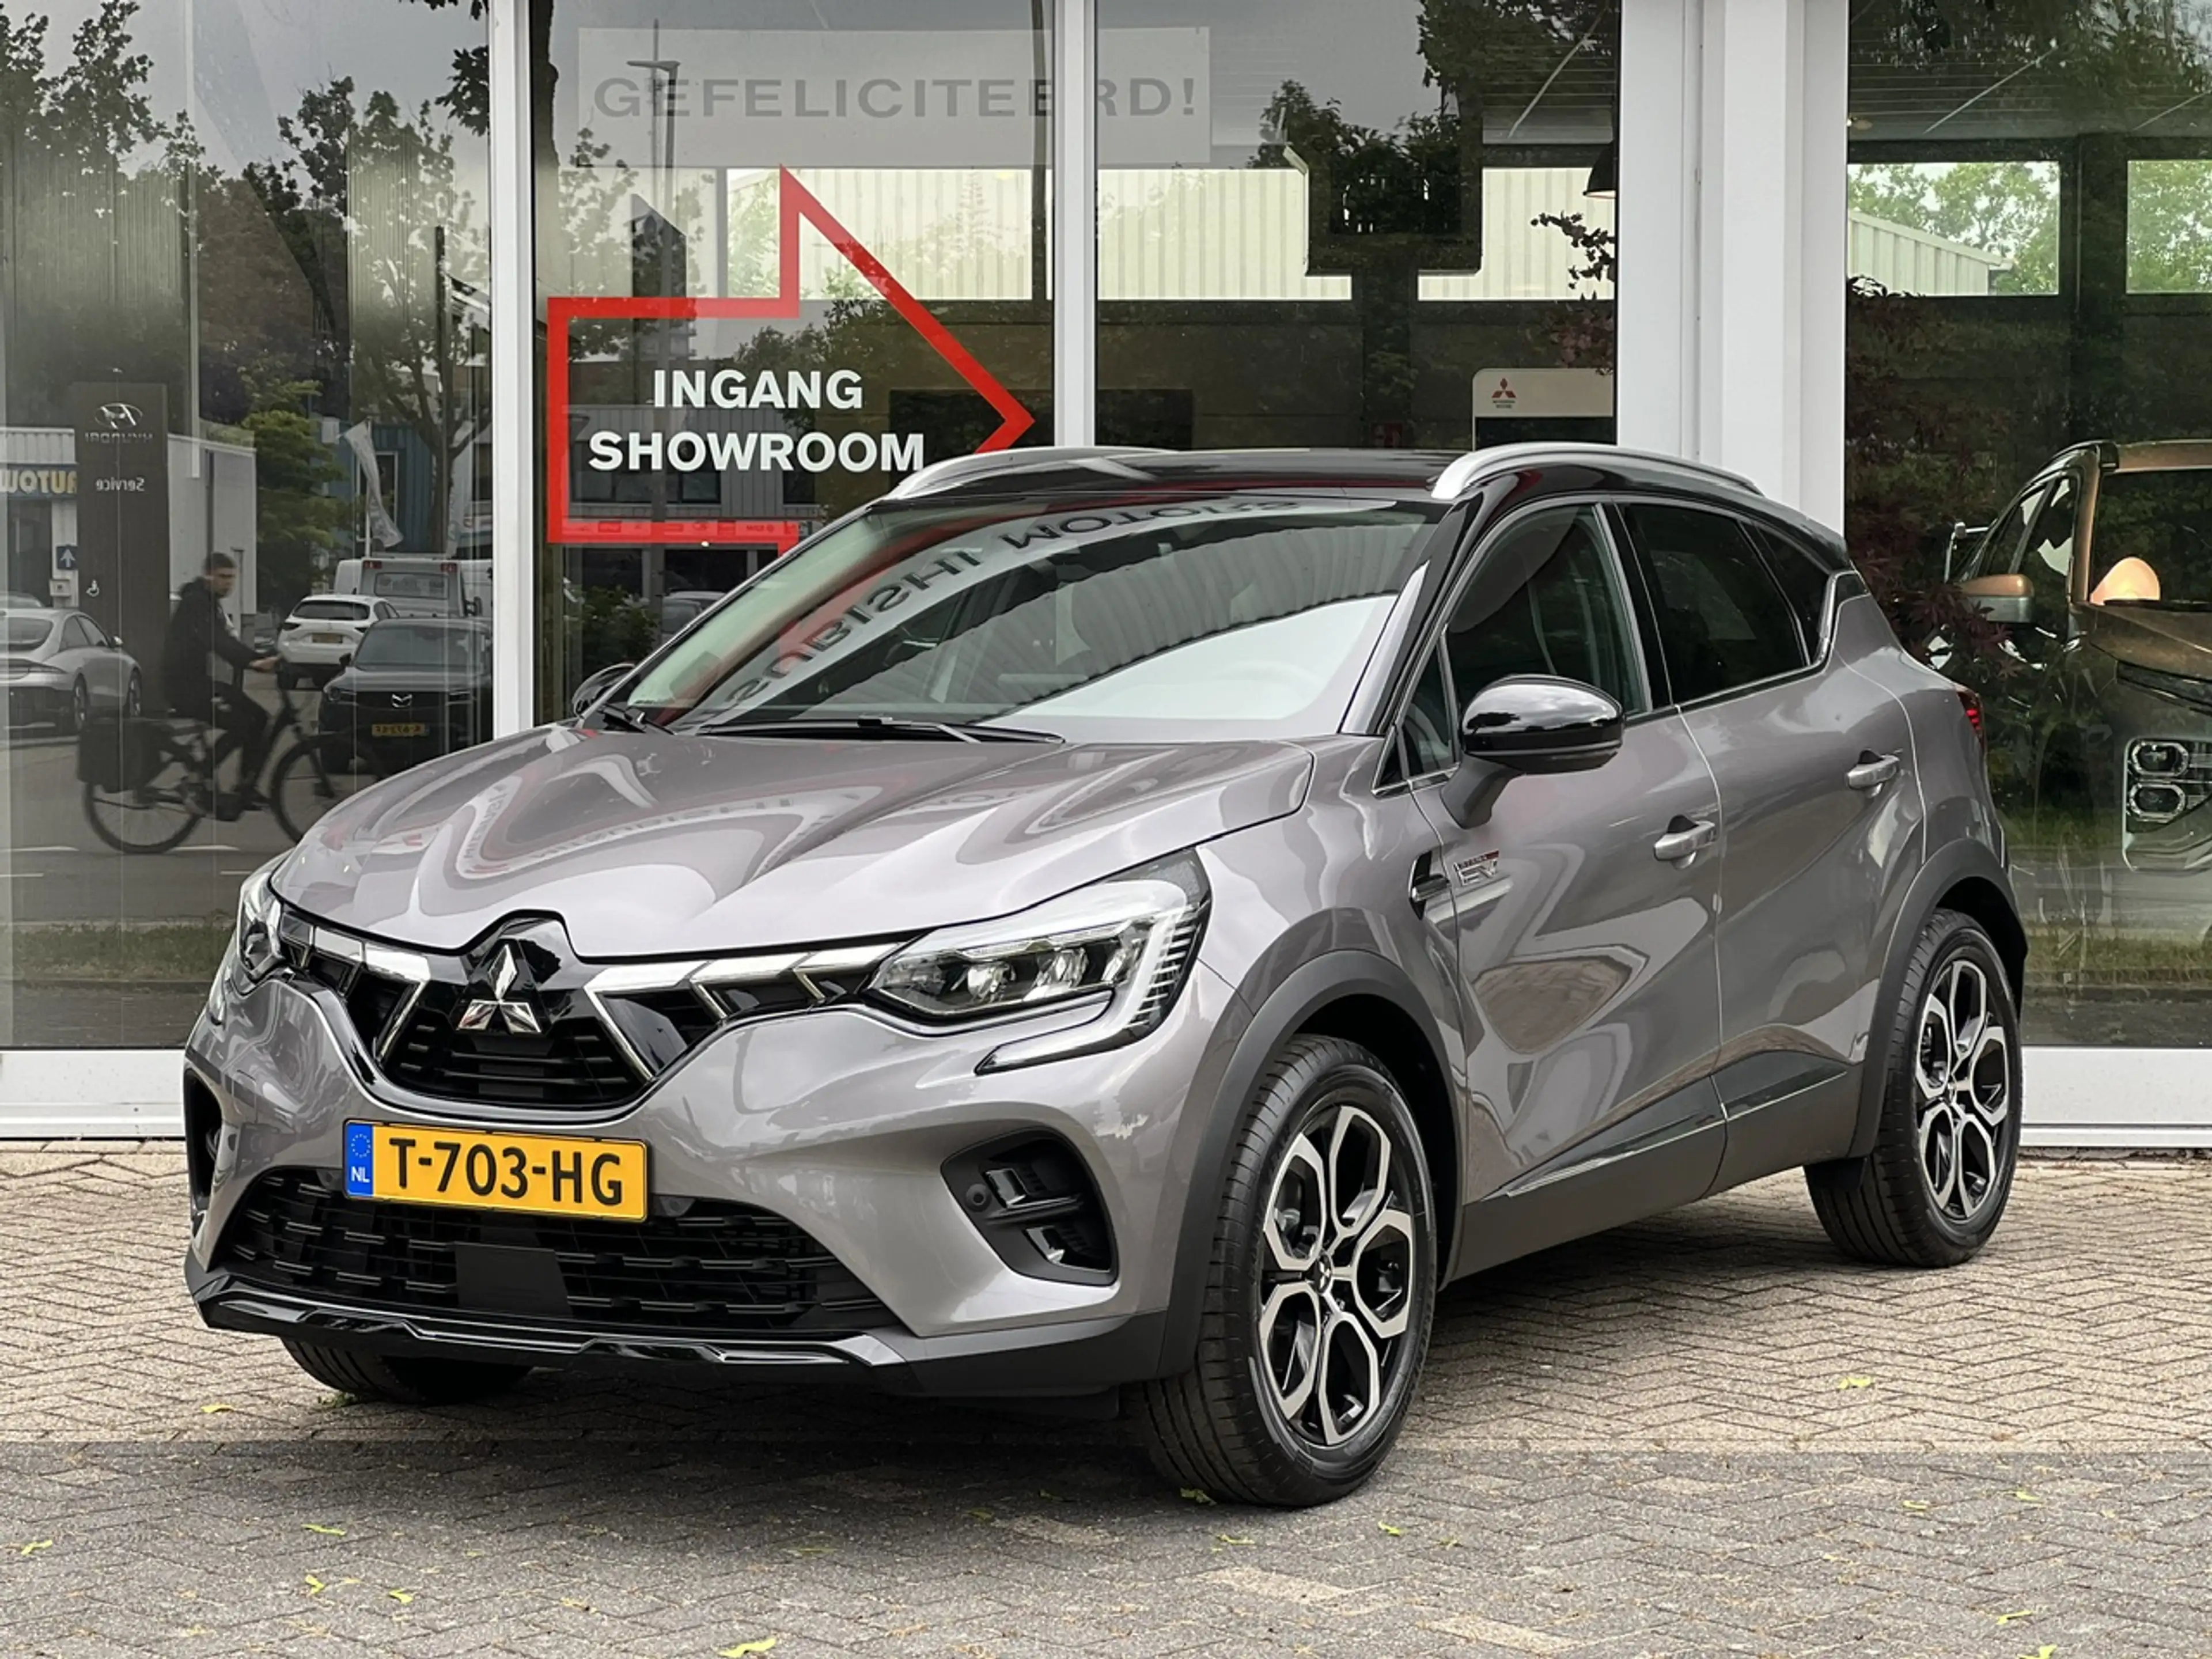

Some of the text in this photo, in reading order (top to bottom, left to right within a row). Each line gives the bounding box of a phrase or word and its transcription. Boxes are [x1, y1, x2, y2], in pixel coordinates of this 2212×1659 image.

[654, 369, 862, 408] INGANG
[589, 430, 924, 472] SHOWROOM
[351, 1167, 370, 1183] NL
[389, 1137, 623, 1206] T-703-HG
